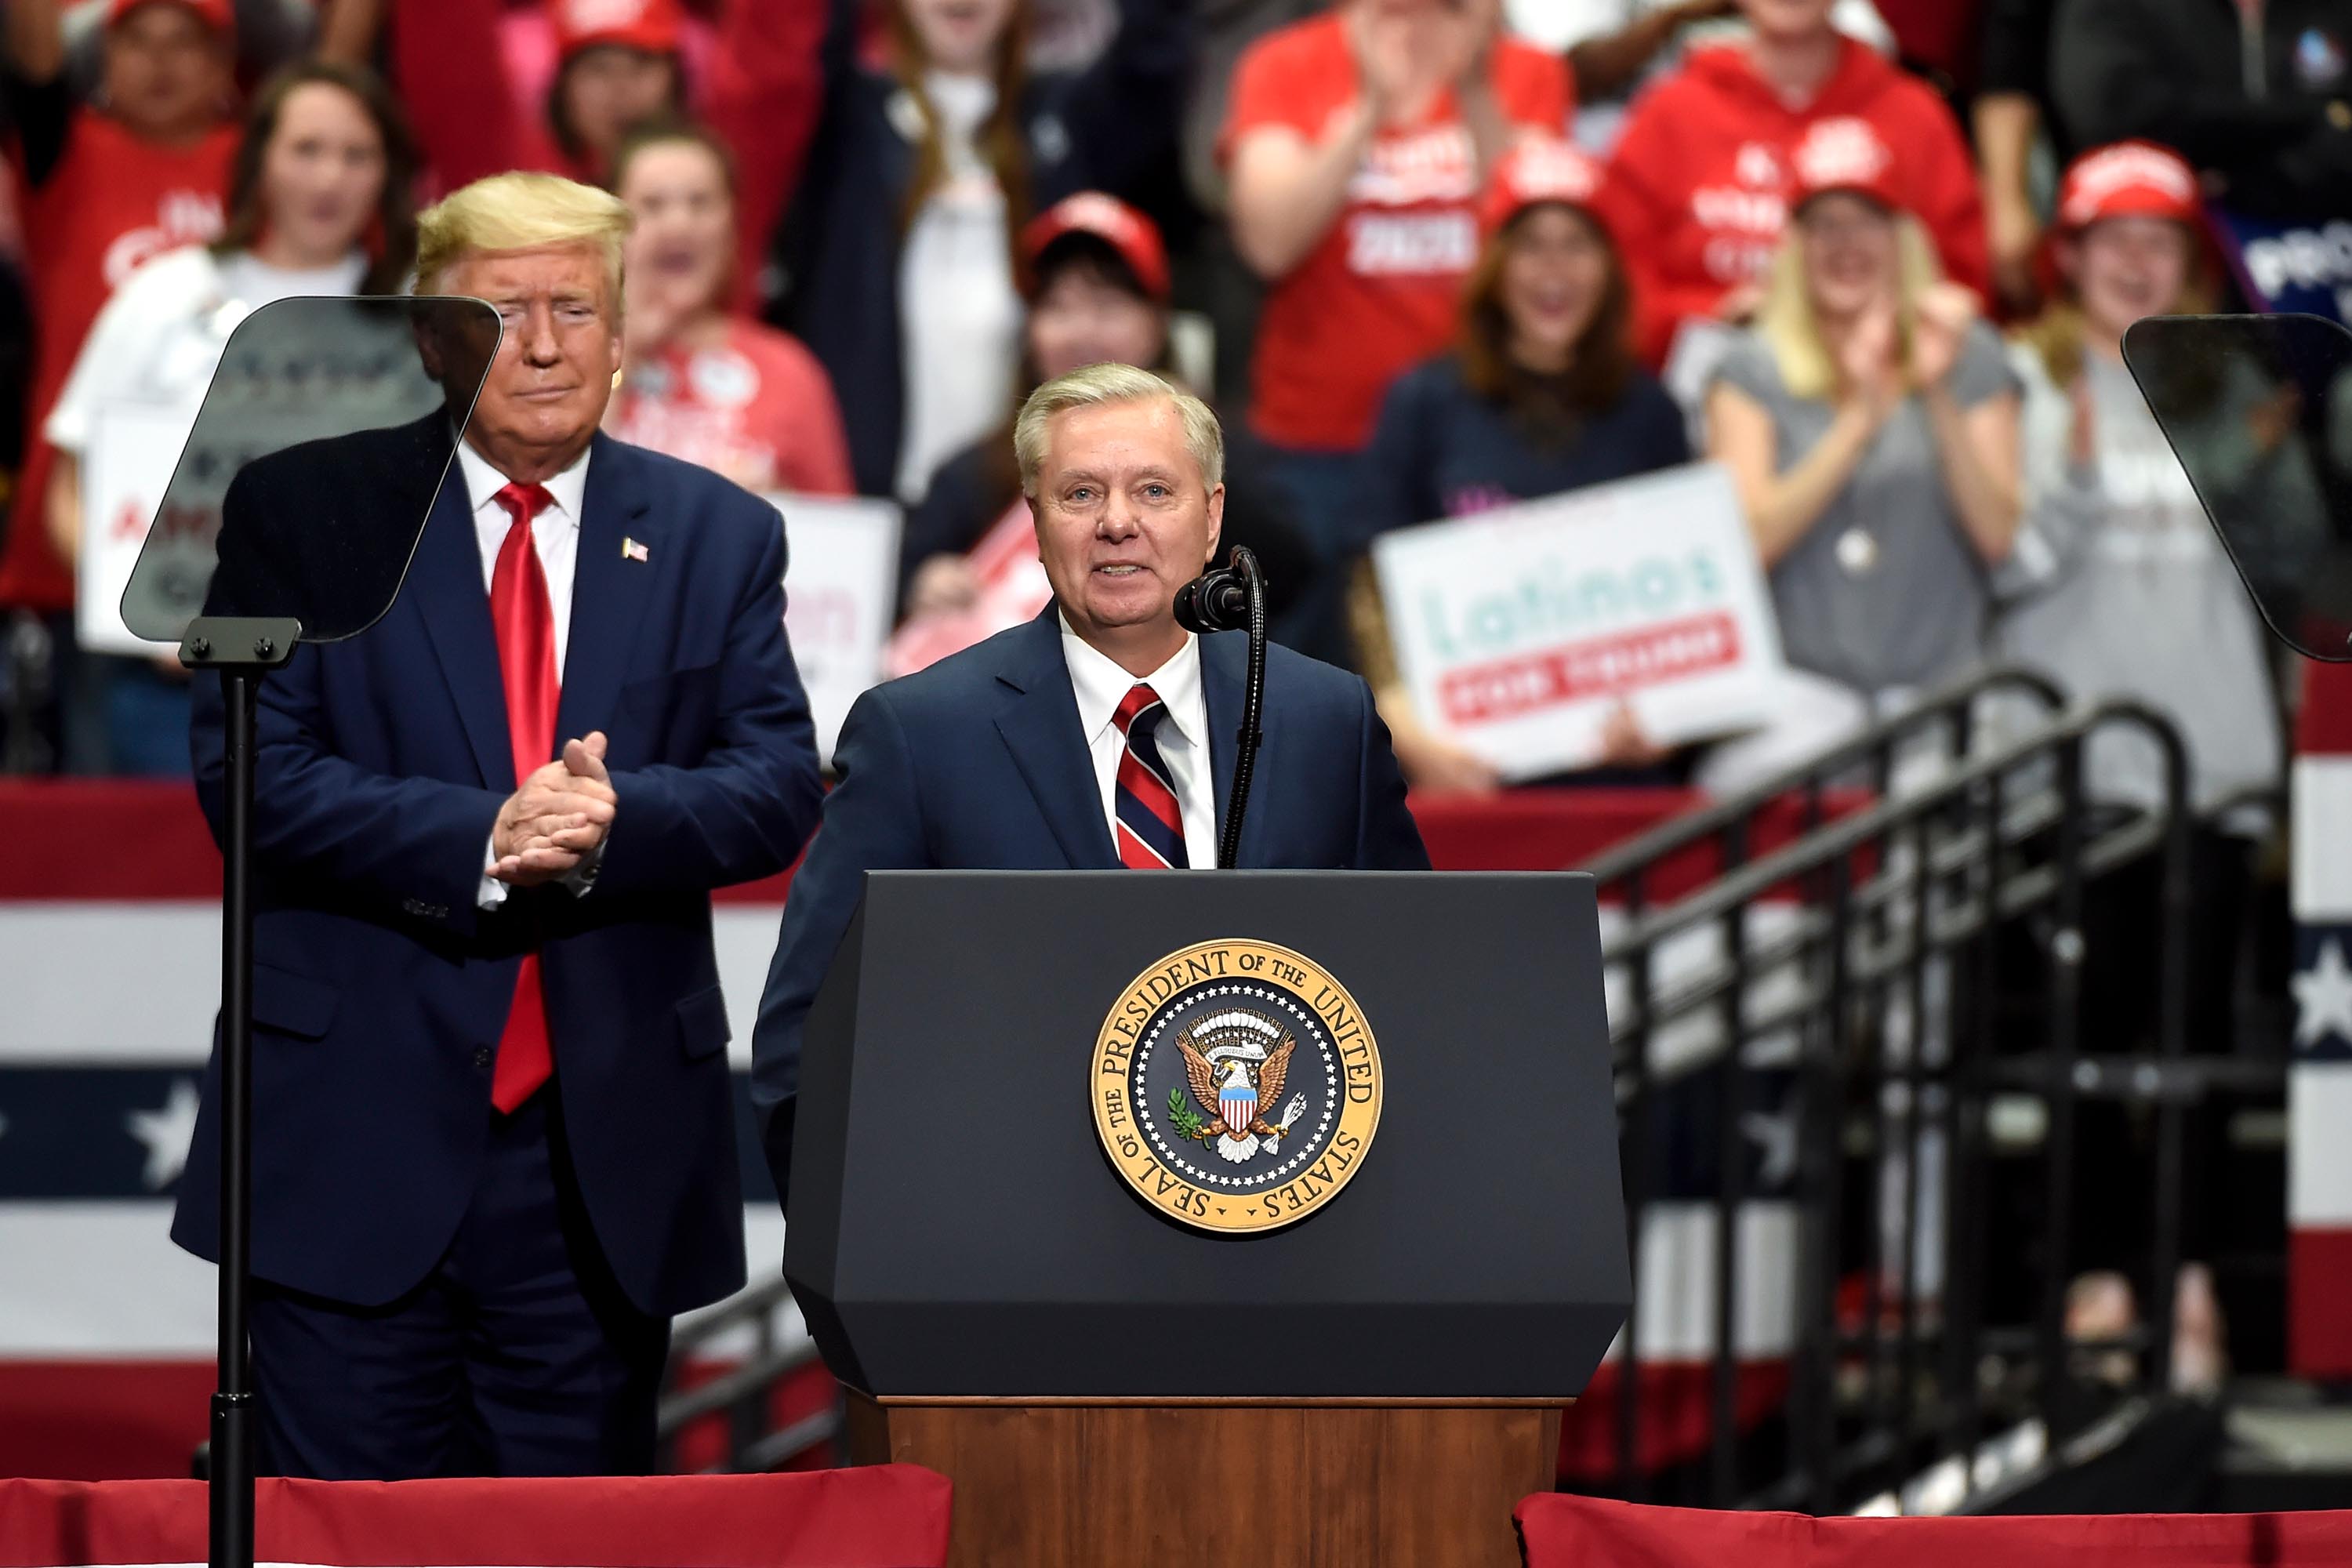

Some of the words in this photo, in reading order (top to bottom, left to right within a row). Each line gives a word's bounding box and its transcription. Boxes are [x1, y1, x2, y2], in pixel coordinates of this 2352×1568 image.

[1418, 546, 1720, 657] Latinos
[1569, 625, 1727, 687] TRUMP
[1239, 953, 1265, 971] OF
[1272, 959, 1307, 988] THE
[1103, 949, 1229, 1077] PRESIDENT
[1213, 1048, 1244, 1057] PLURIBUS
[1314, 985, 1373, 1104] UNITED
[1105, 1088, 1127, 1128] THE
[1116, 1133, 1139, 1158] OF
[1263, 1131, 1360, 1218] STATES
[1138, 1156, 1210, 1217] SEAL
